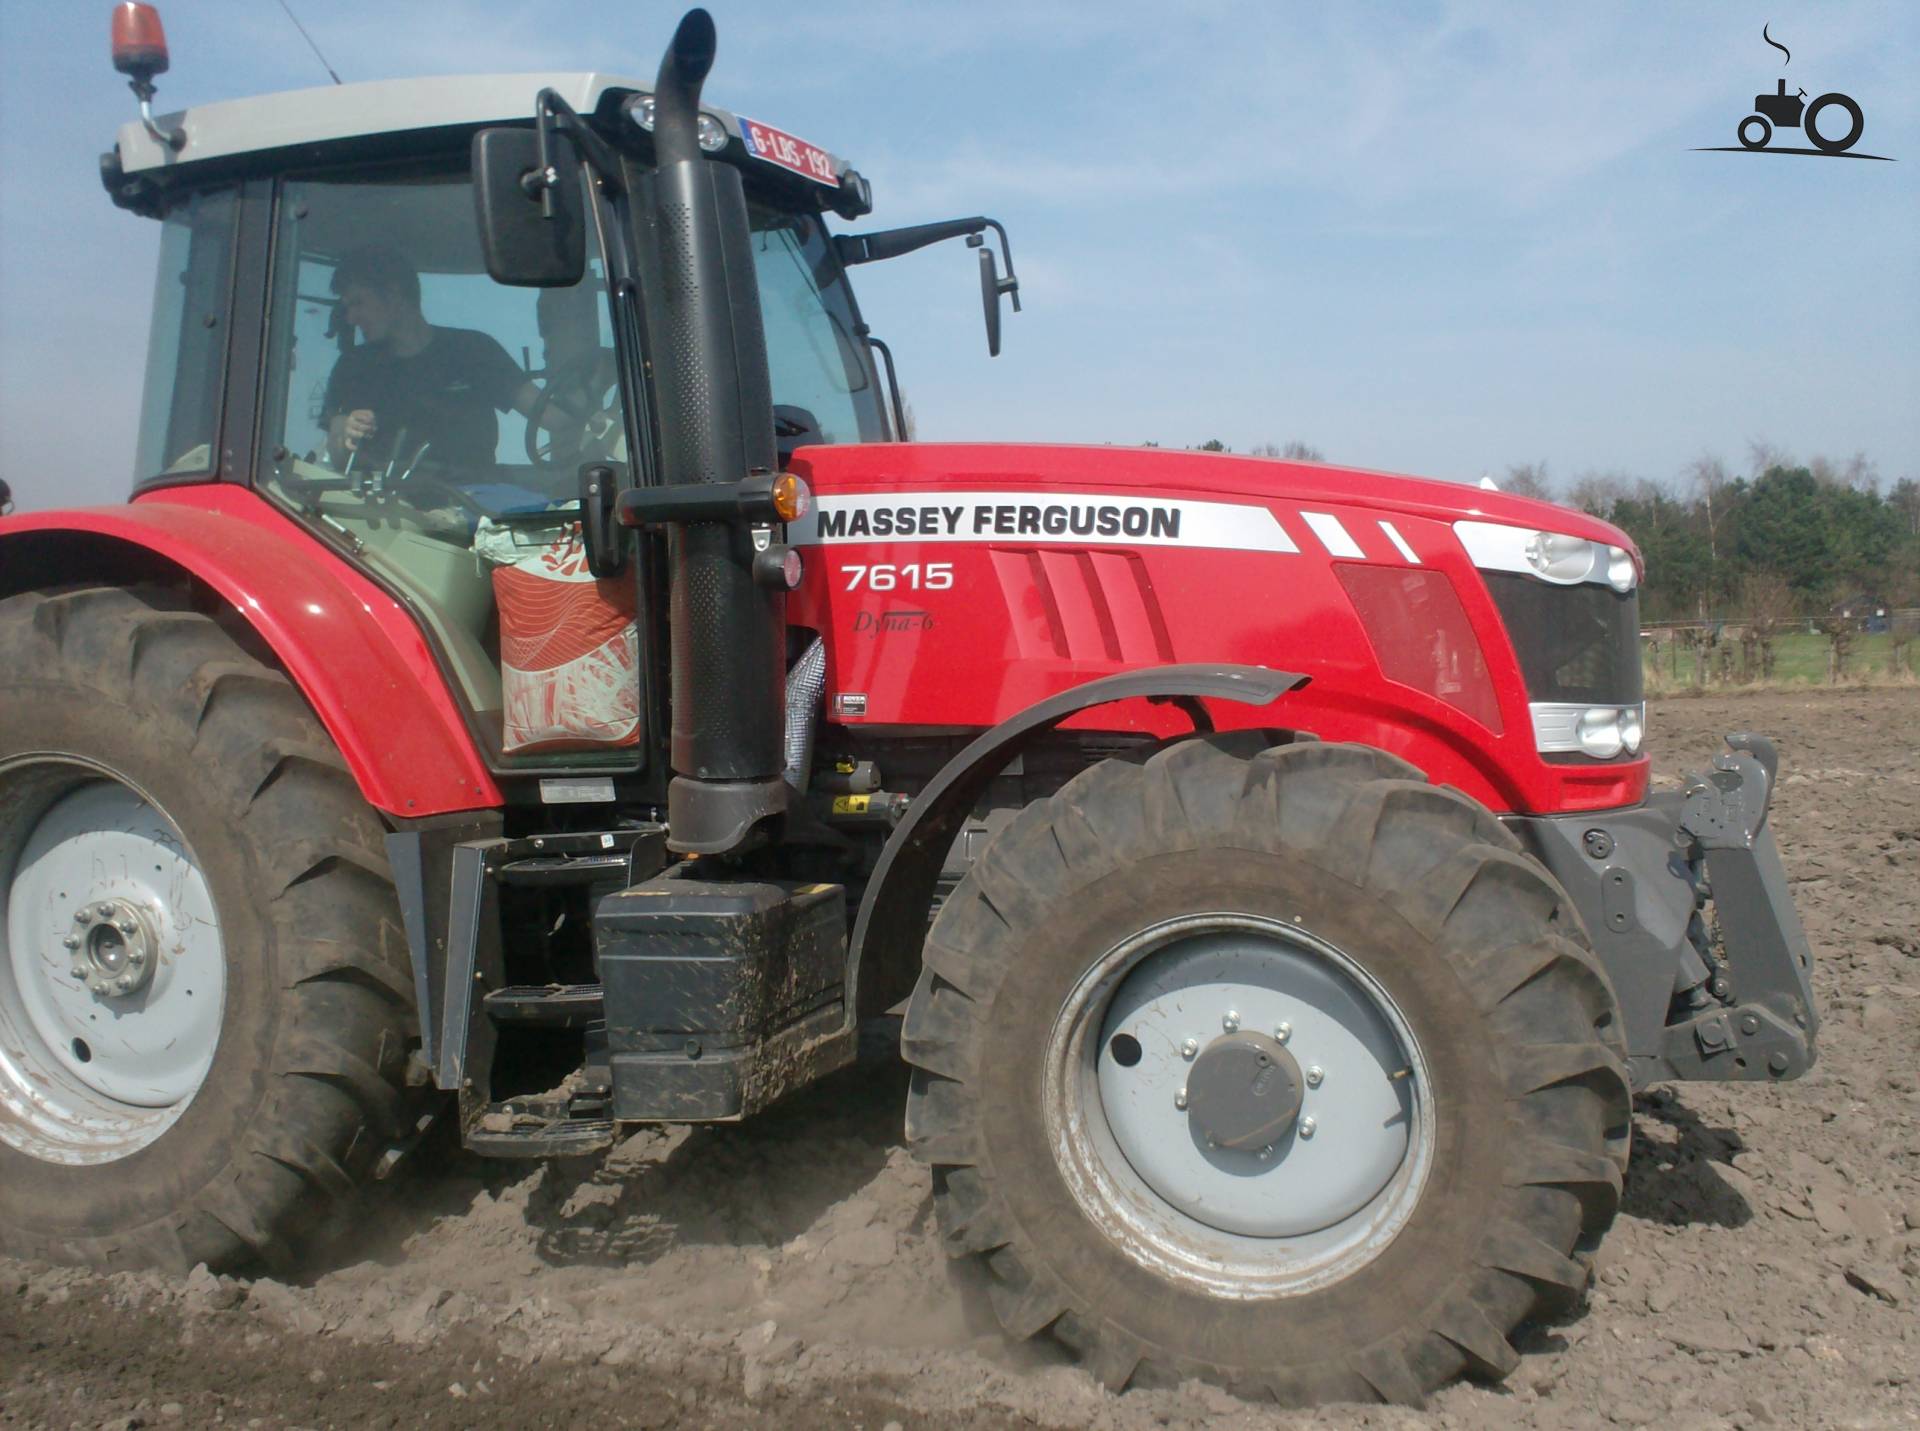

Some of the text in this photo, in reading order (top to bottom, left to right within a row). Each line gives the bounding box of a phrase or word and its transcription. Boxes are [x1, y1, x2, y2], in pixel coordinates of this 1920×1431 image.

[817, 505, 1181, 538] MASSEY FERGUSON
[840, 563, 954, 592] 7615
[853, 610, 935, 639] Dyna-6
